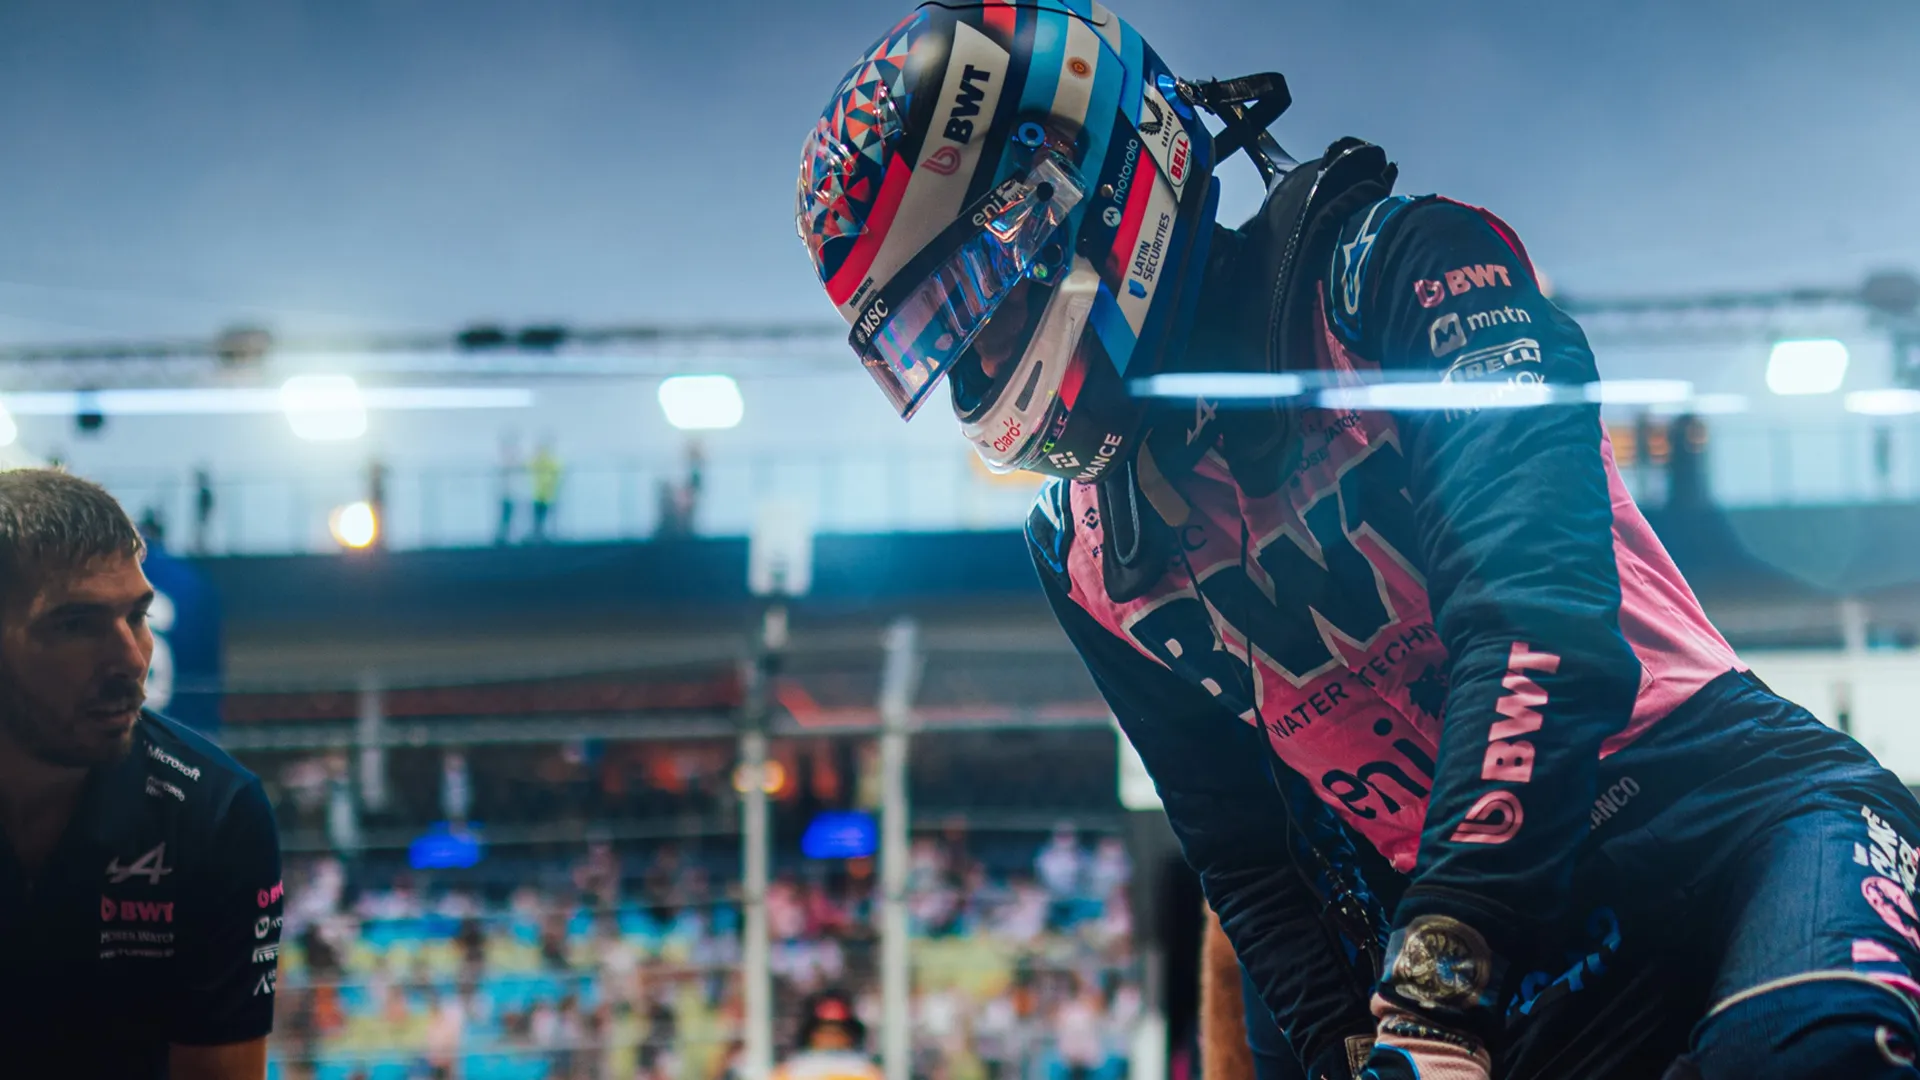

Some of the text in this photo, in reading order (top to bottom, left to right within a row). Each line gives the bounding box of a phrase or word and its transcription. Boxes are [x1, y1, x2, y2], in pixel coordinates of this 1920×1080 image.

[943, 64, 990, 145] BWT
[1112, 138, 1139, 204] motorola
[1170, 136, 1189, 181] BELL
[972, 195, 1003, 226] eni
[1132, 240, 1151, 277] LATIN
[1143, 212, 1170, 282] SECURITIES
[1444, 263, 1512, 297] BWT
[859, 298, 889, 338] MSC
[1467, 305, 1531, 332] mntn
[993, 422, 1021, 453] Claro
[1076, 433, 1123, 482] NANCE
[1267, 620, 1436, 740] WATER TECHN
[1481, 641, 1561, 783] BWT
[147, 744, 201, 782] Microsoft
[1321, 718, 1435, 820] eni
[1590, 776, 1641, 831] ANCO
[120, 900, 175, 925] BWT
